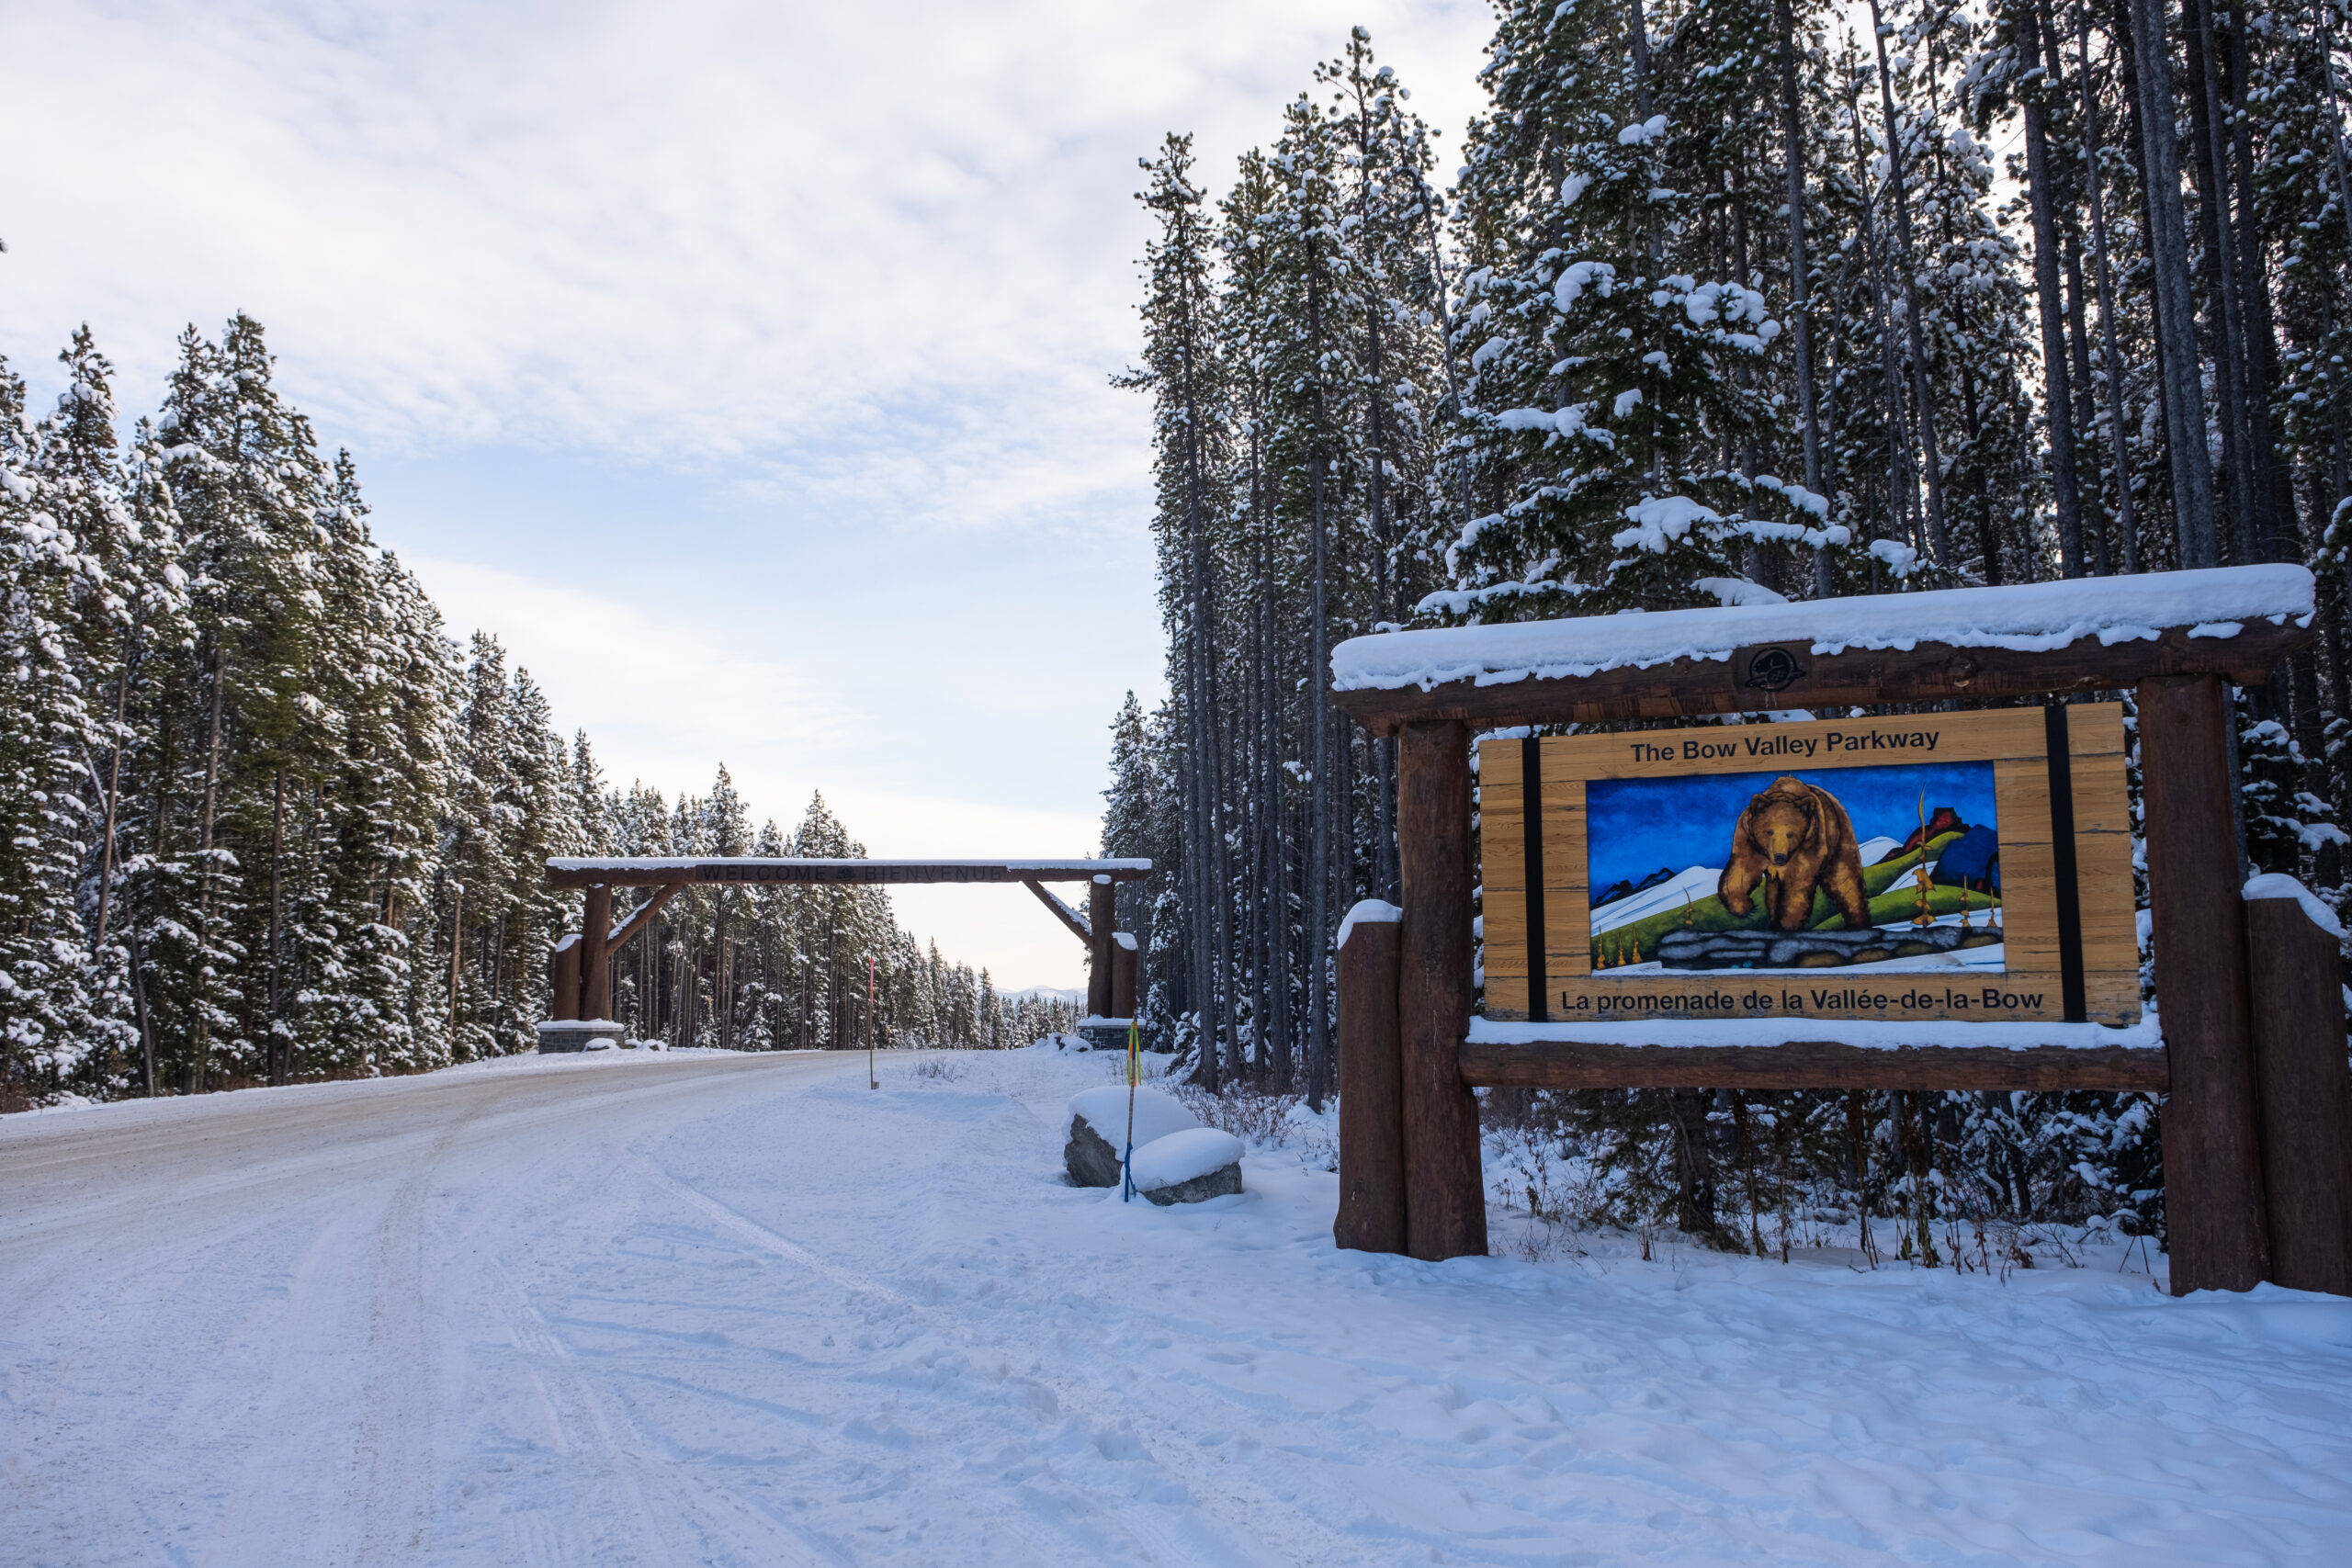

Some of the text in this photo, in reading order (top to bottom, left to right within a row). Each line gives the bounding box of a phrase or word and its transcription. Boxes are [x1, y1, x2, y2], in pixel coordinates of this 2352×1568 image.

[1630, 729, 1940, 762] The Bow Valley Parkway
[703, 865, 1001, 881] WELCOME BIENVENUE
[1562, 987, 2044, 1015] La promenade de la Vallée-de-la-Bow
